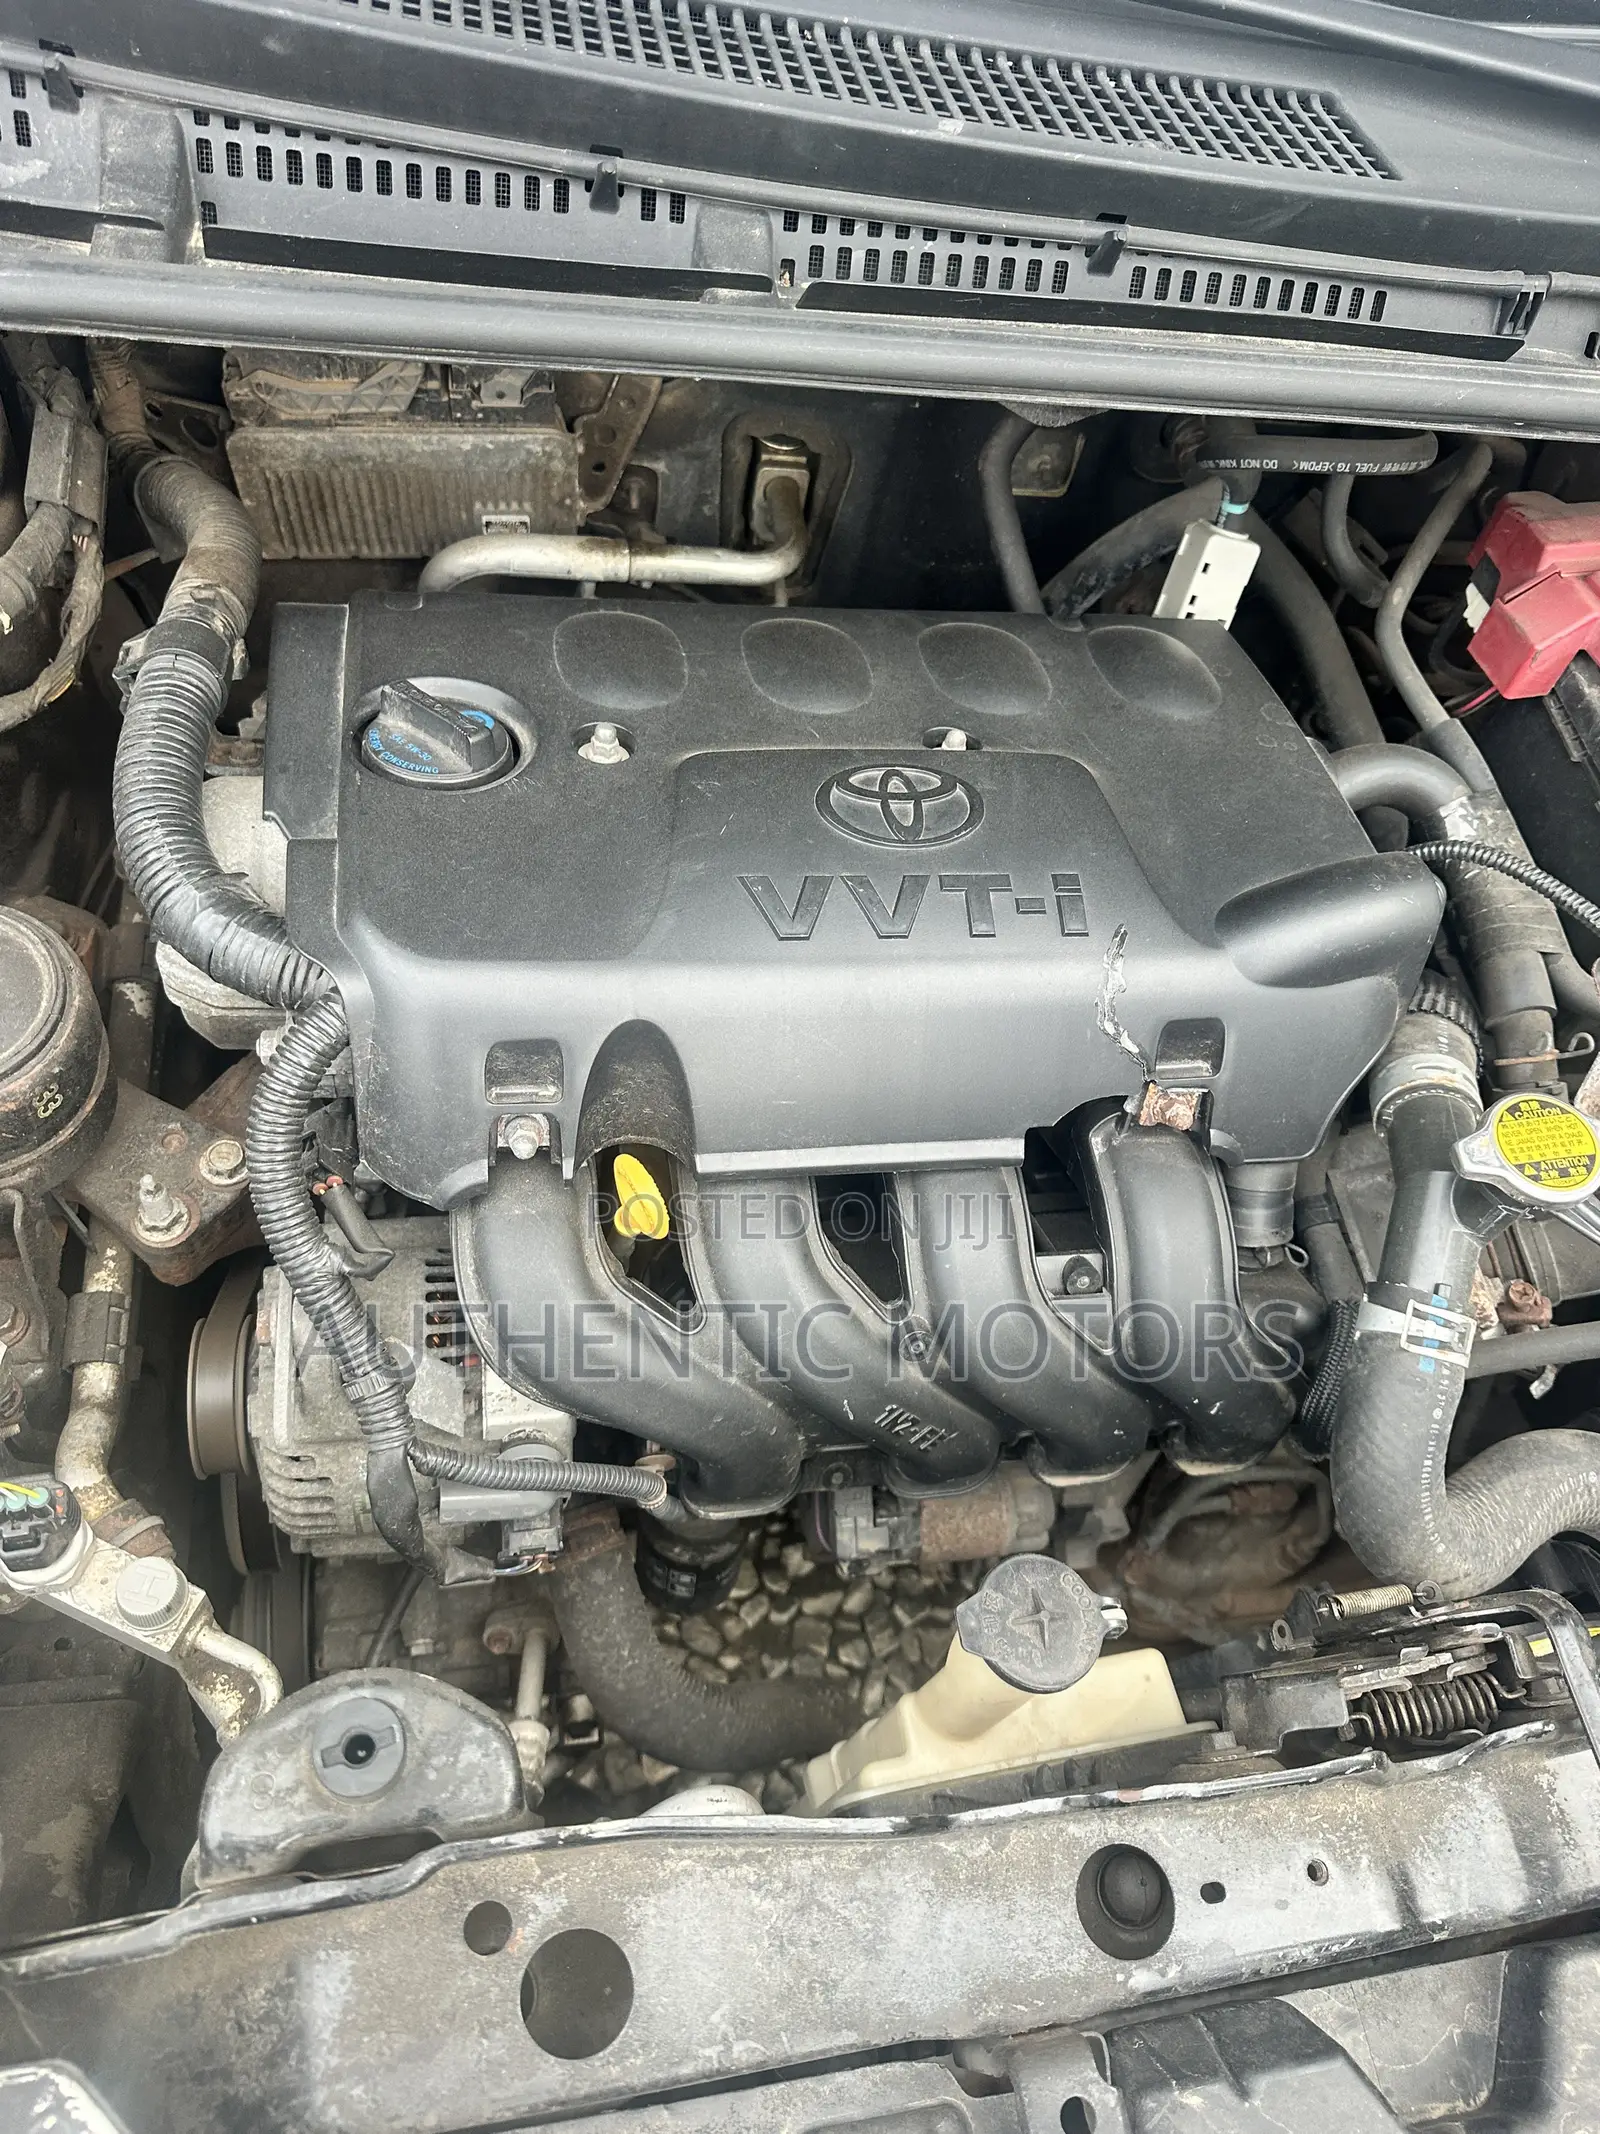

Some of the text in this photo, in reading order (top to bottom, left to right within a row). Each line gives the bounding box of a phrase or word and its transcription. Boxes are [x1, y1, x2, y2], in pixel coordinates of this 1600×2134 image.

[1240, 458, 1261, 469] NOT
[1263, 458, 1278, 470] DO
[1336, 461, 1350, 473] TG
[1355, 462, 1380, 474] FUEL
[390, 732, 433, 763] SAE 5W-30
[379, 750, 439, 775] CONSERVING
[733, 873, 1090, 941] VVT-i
[1514, 1107, 1561, 1120] CAUTION
[1501, 1122, 1579, 1139] NEVER OPEN WHEN HOT
[1504, 1139, 1514, 1147] NE
[1515, 1137, 1536, 1146] JAMAIS
[1564, 1131, 1583, 1139] CHAUD
[1540, 1156, 1590, 1170] ATTENTION
